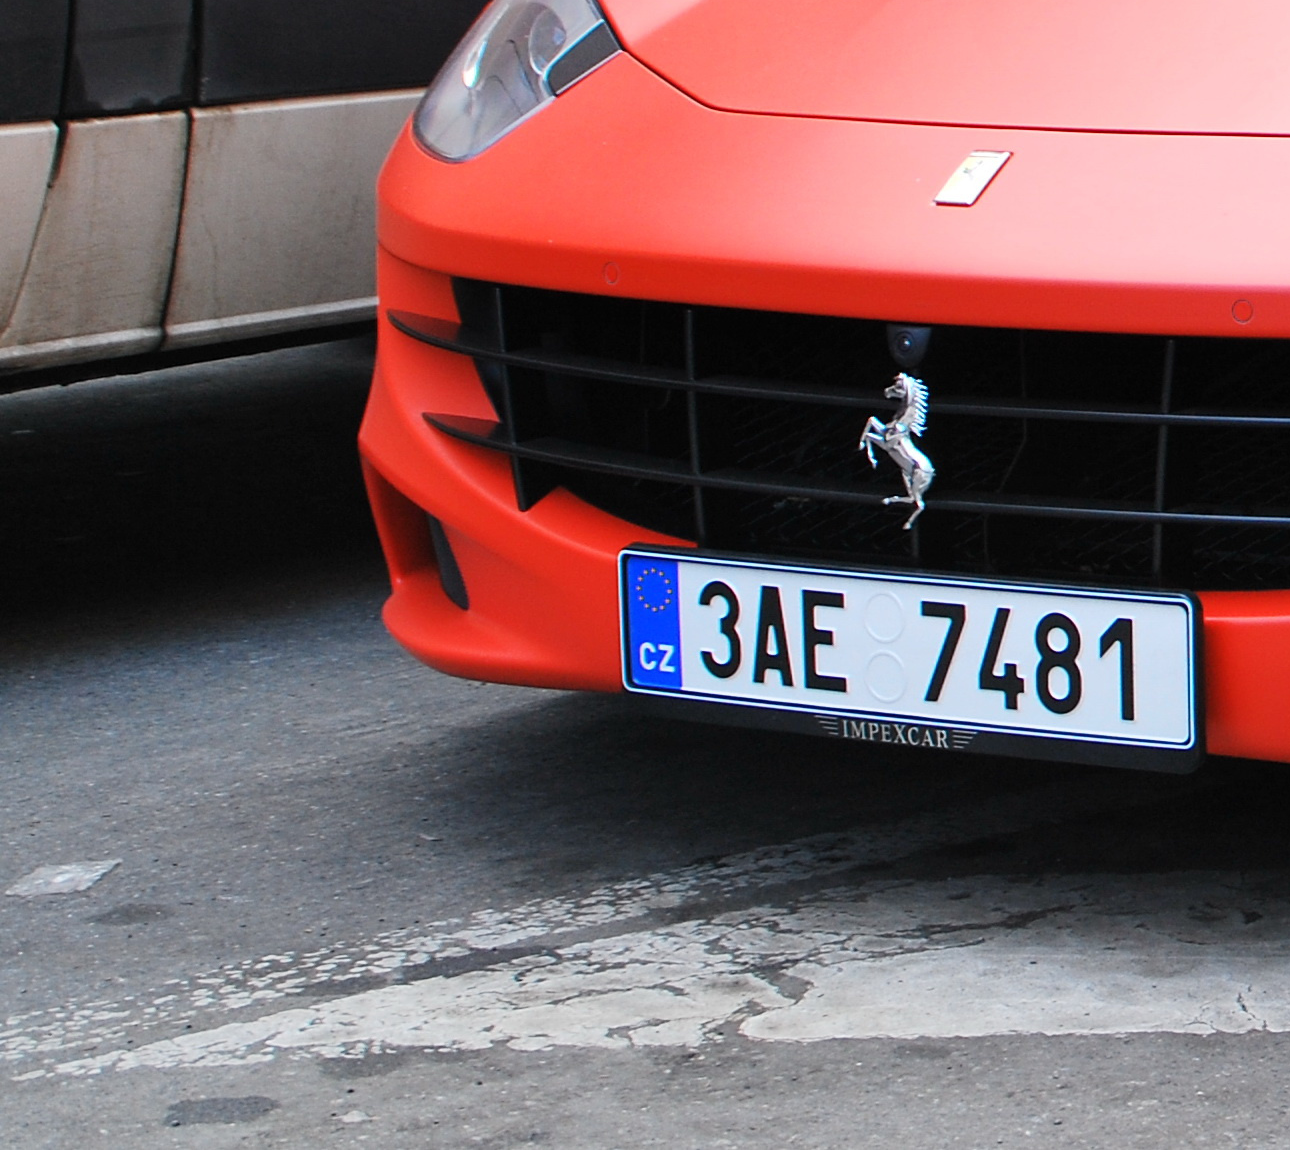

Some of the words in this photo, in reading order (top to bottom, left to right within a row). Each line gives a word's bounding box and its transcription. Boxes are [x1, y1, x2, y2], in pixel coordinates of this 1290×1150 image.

[638, 640, 676, 673] CZ
[698, 580, 848, 693] 3AE
[920, 601, 1136, 722] 7481
[842, 719, 949, 748] IMPEXCAR
